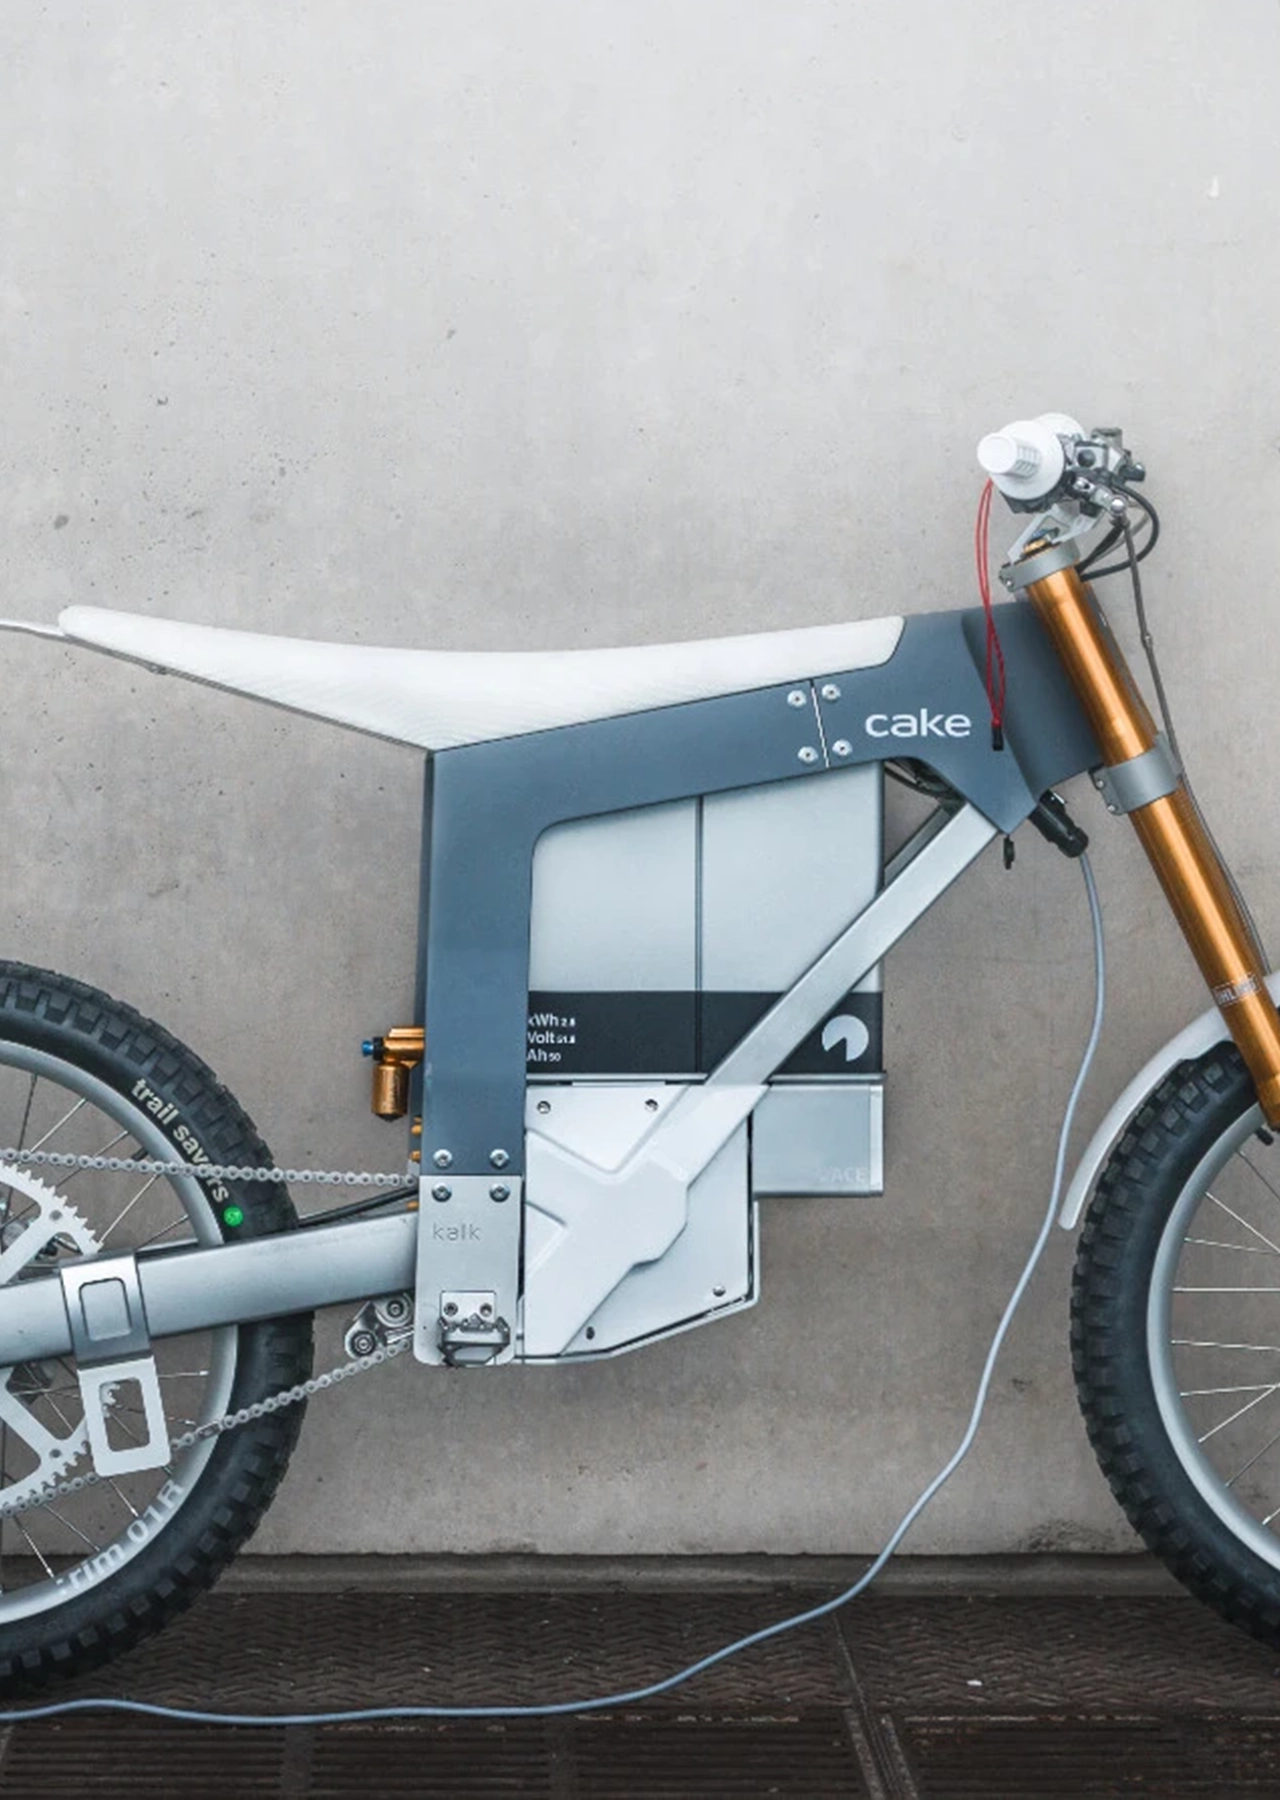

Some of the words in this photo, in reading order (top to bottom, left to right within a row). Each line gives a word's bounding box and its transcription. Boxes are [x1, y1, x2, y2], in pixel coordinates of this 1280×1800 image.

[865, 708, 971, 738] cake
[527, 1030, 555, 1044] Volt
[526, 1048, 548, 1062] Ah
[131, 1078, 180, 1125] trail
[173, 1124, 230, 1203] savrs
[432, 1221, 481, 1241] kalk
